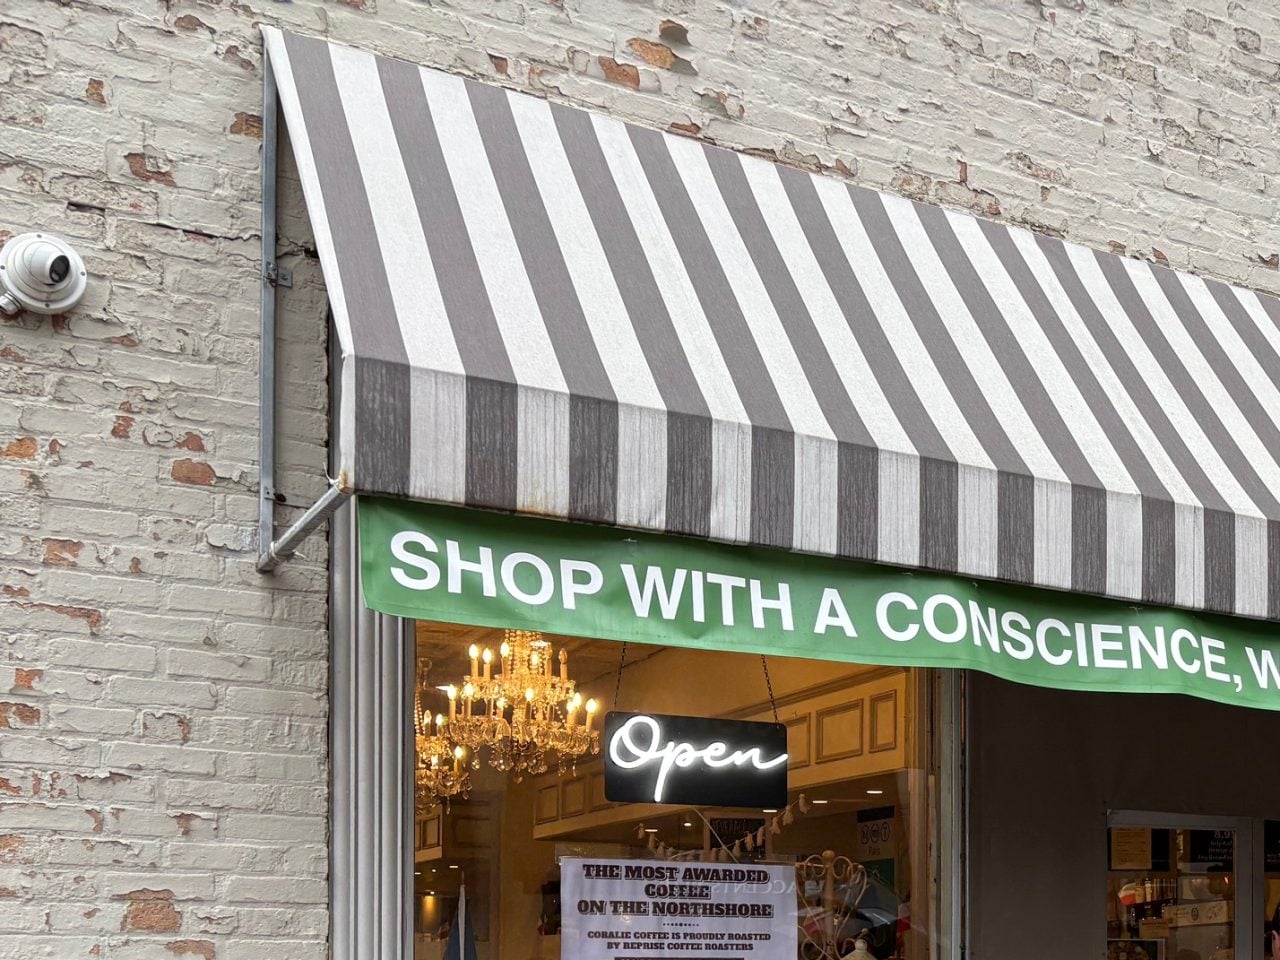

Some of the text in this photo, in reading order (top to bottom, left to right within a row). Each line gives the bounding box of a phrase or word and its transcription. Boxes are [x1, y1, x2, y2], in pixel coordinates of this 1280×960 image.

[390, 530, 603, 610] SHOP
[620, 563, 794, 631] WITH
[813, 588, 857, 638] A
[875, 592, 1242, 692] CONSCIENCE,
[609, 715, 789, 802] Open
[583, 864, 770, 883] THE MOST AWARDED
[644, 884, 711, 899] COFFEE
[577, 900, 774, 918] ON THE NORTHSHORE
[587, 931, 771, 941] CORALIE COFFEE IS PROUDLY ROASTED
[623, 942, 665, 950] REPRISE
[667, 943, 703, 951] COFFEE
[705, 943, 754, 951] ROASTERS
